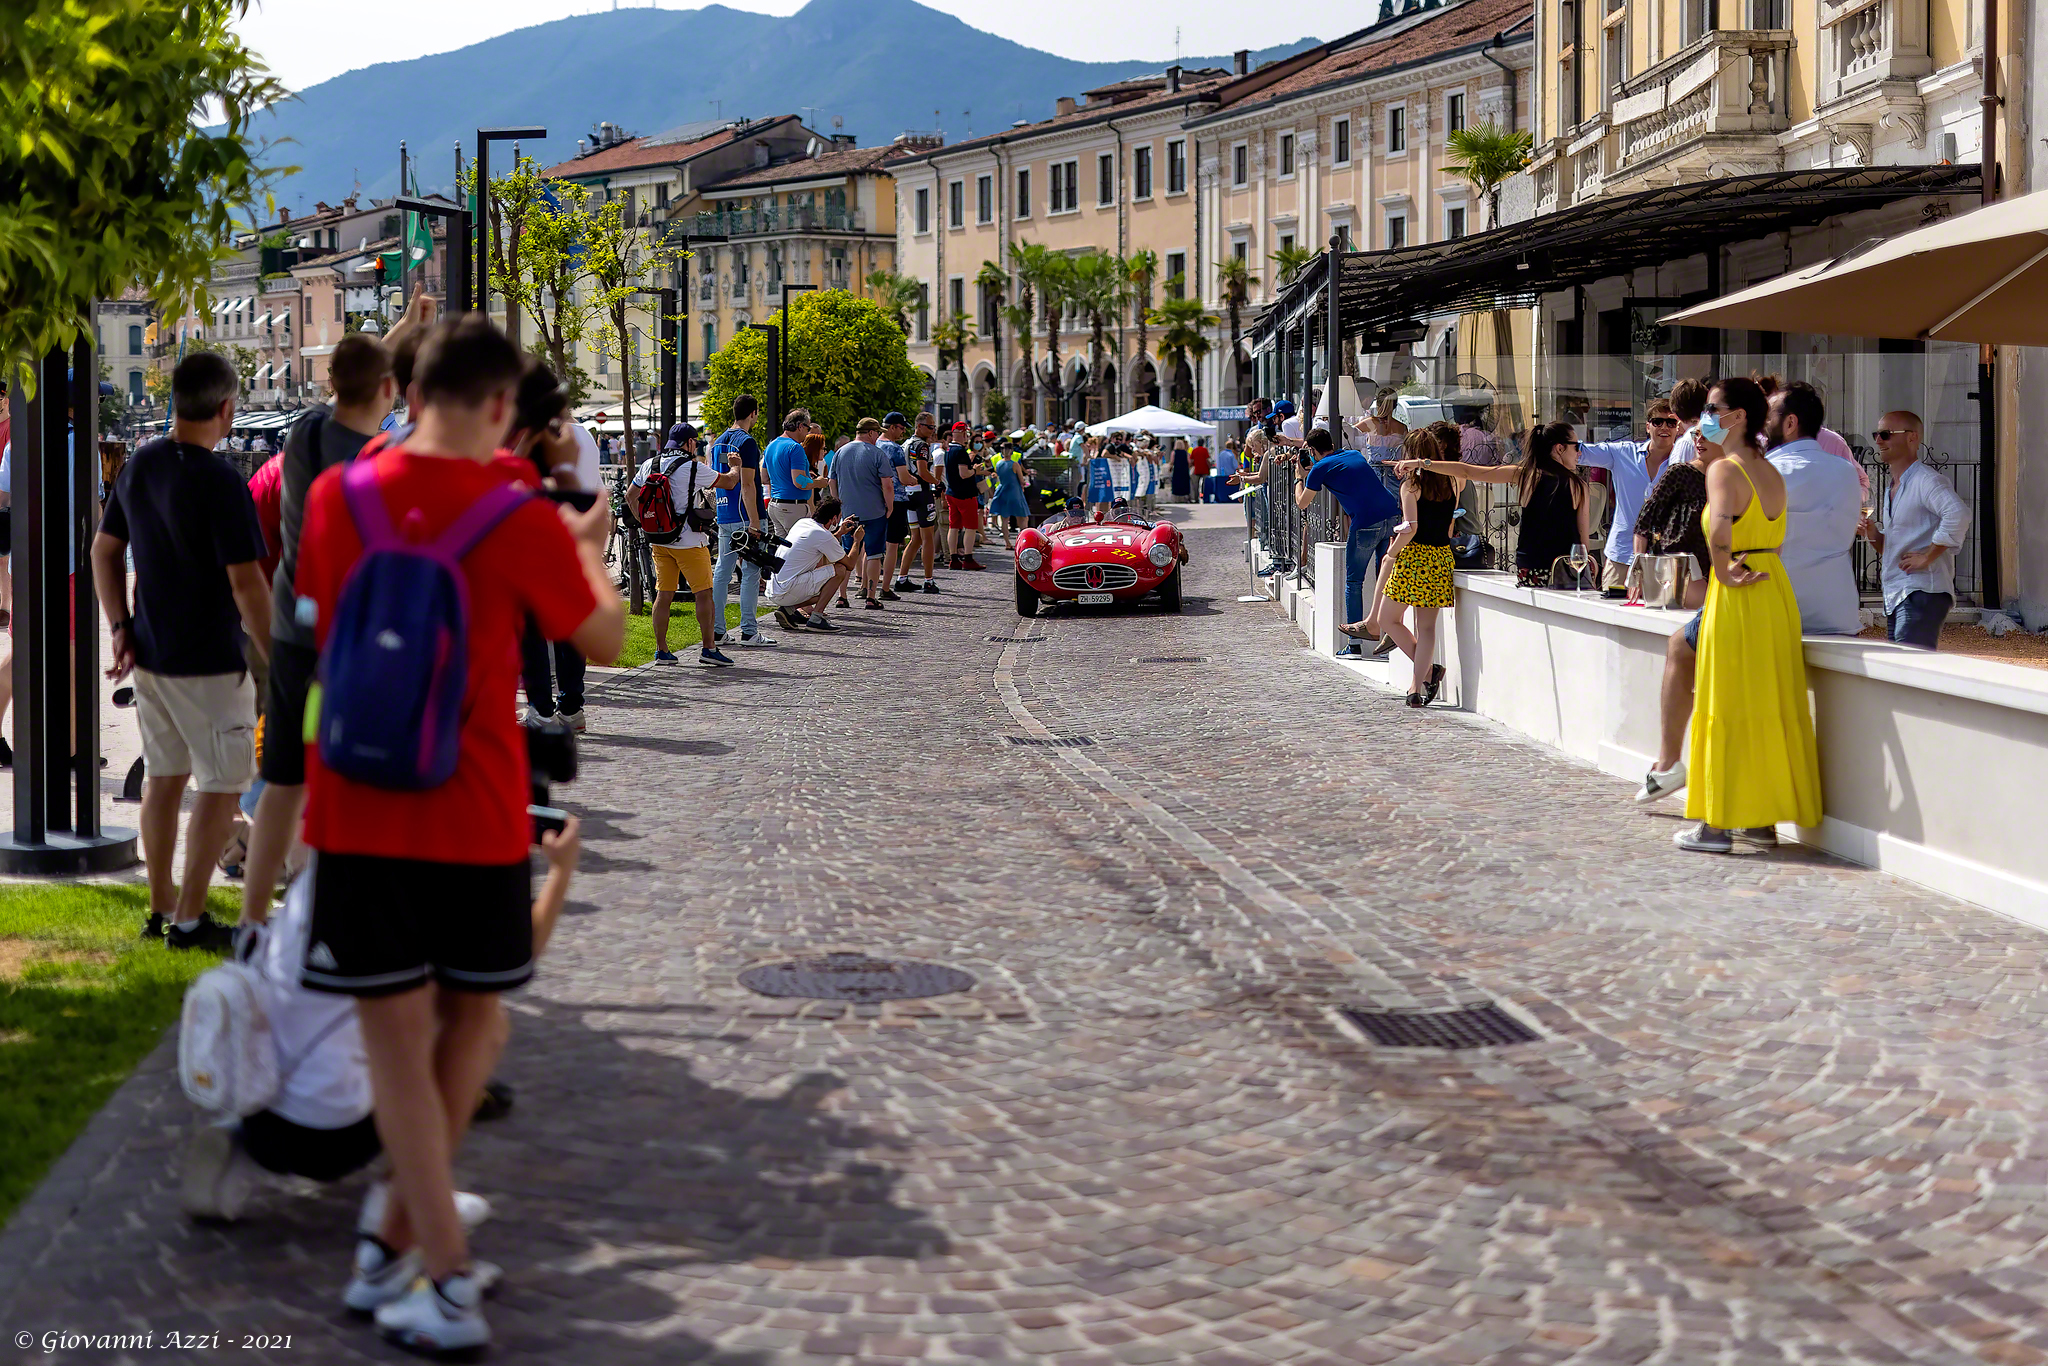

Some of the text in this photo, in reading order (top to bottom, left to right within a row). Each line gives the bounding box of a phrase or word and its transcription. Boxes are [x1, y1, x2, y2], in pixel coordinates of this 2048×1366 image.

[1065, 534, 1132, 546] 641
[1111, 549, 1136, 559] 277
[1091, 594, 1111, 603] 59295
